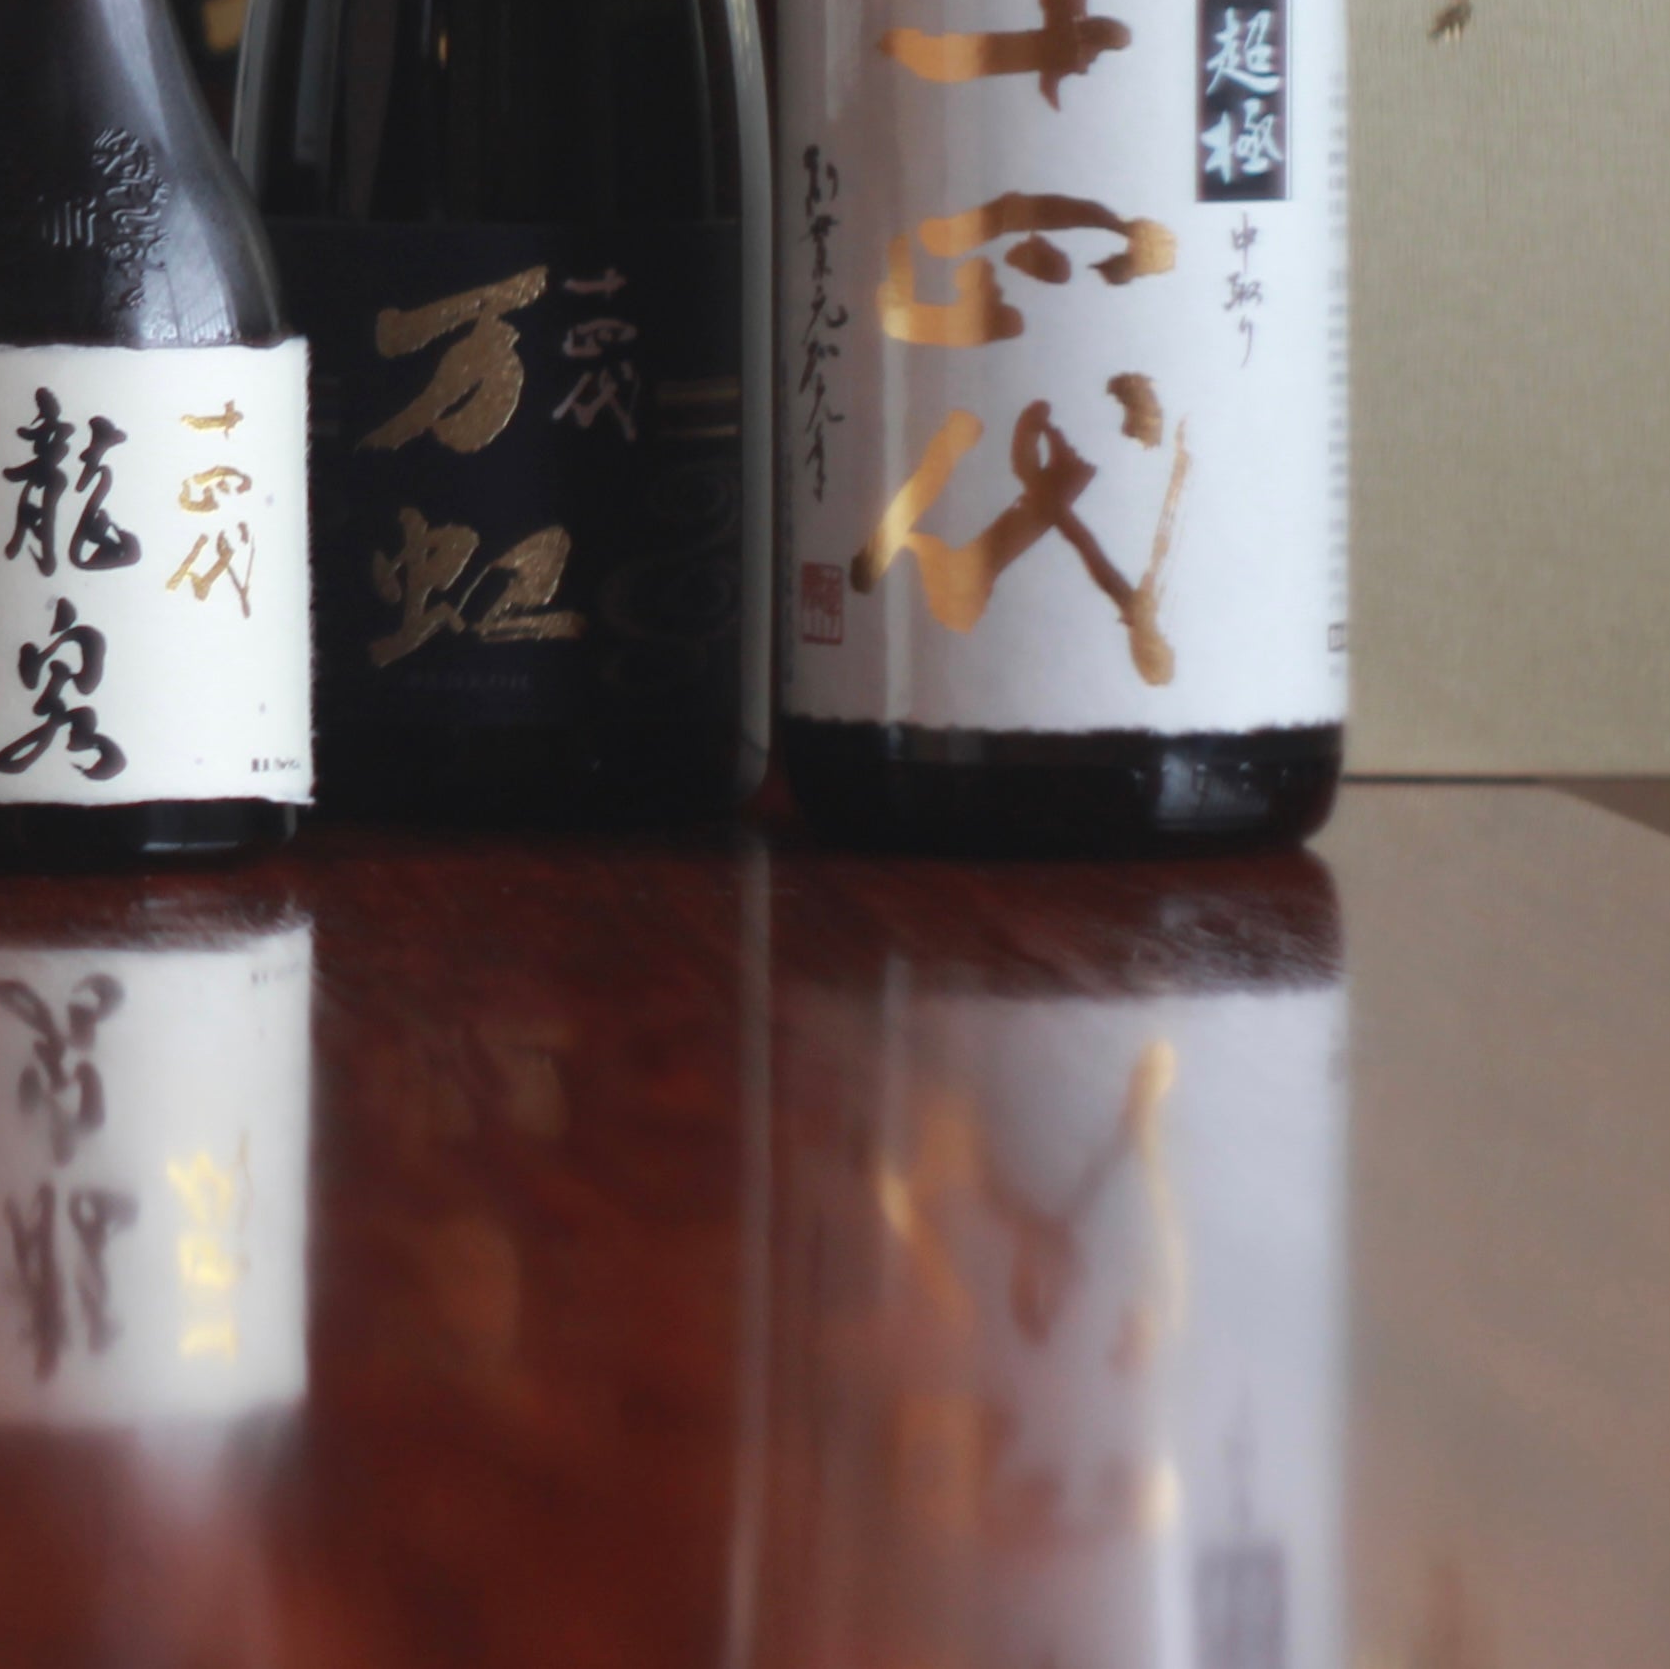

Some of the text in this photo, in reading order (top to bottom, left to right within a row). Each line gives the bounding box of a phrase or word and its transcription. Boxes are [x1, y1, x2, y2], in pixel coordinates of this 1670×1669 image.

[552, 267, 638, 441] 十四代
[166, 399, 255, 618] 十四代
